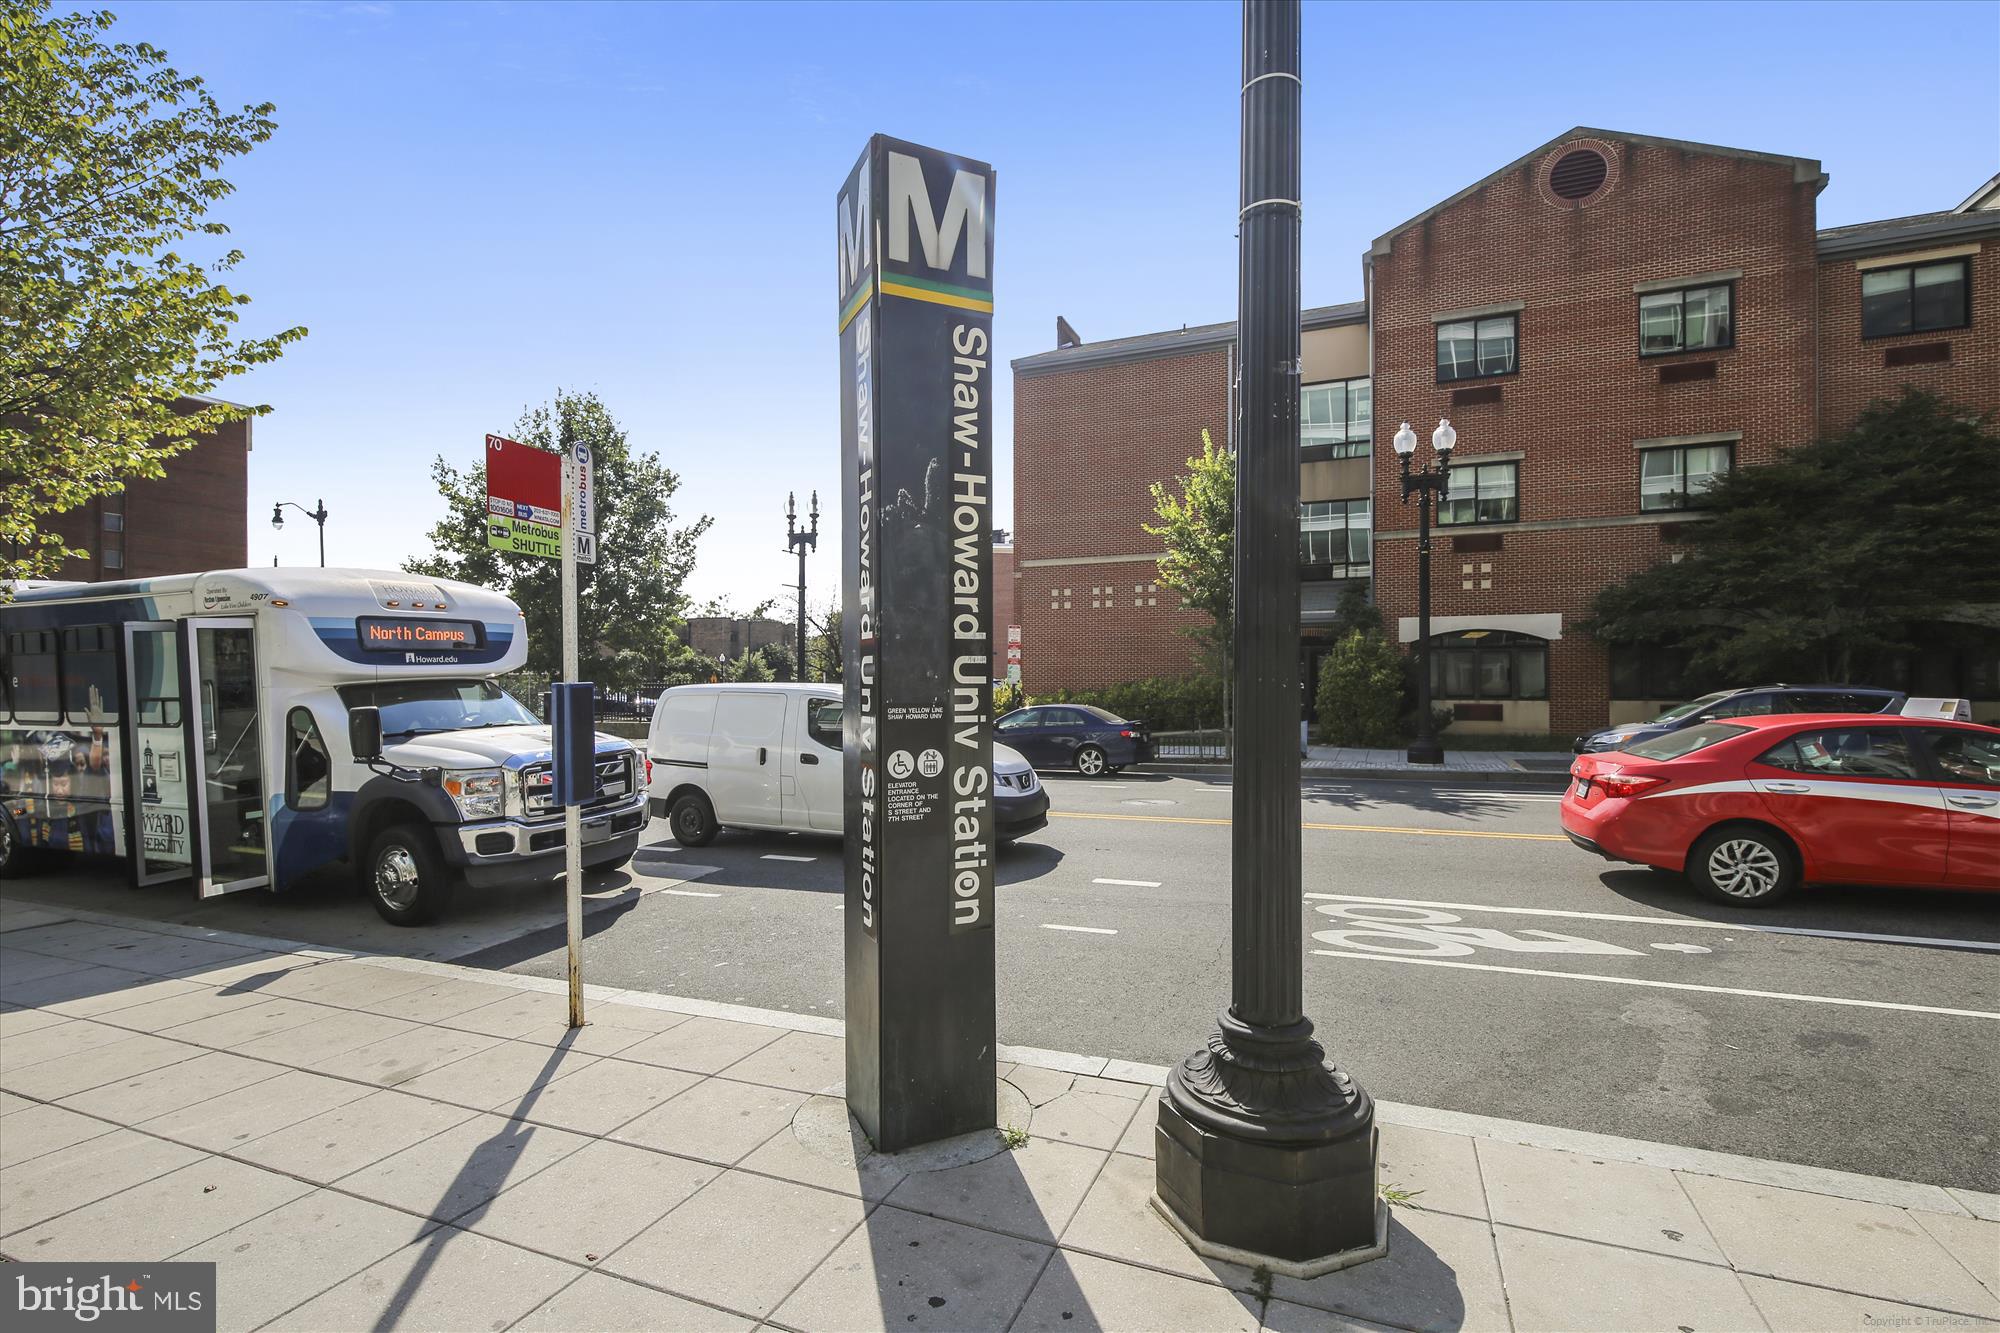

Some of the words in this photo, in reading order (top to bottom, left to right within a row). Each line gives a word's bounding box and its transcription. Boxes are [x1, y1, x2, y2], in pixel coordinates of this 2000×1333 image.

[889, 151, 986, 279] M
[839, 157, 870, 301] M
[487, 436, 502, 451] 70
[953, 325, 988, 640] Shaw-Howard
[578, 466, 587, 529] metrobus
[512, 520, 559, 541] Metrobus
[512, 537, 562, 556] SHUTTLE
[577, 536, 590, 555] M
[250, 593, 269, 601] 4907
[369, 625, 412, 640] North
[415, 626, 465, 641] Campus
[415, 655, 458, 664] Howard.edu
[860, 656, 876, 751] Univ
[953, 655, 987, 750] Univ
[142, 813, 185, 835] WARD
[144, 837, 185, 855] ERSTY
[861, 766, 875, 928] Station
[953, 765, 988, 925] Station
